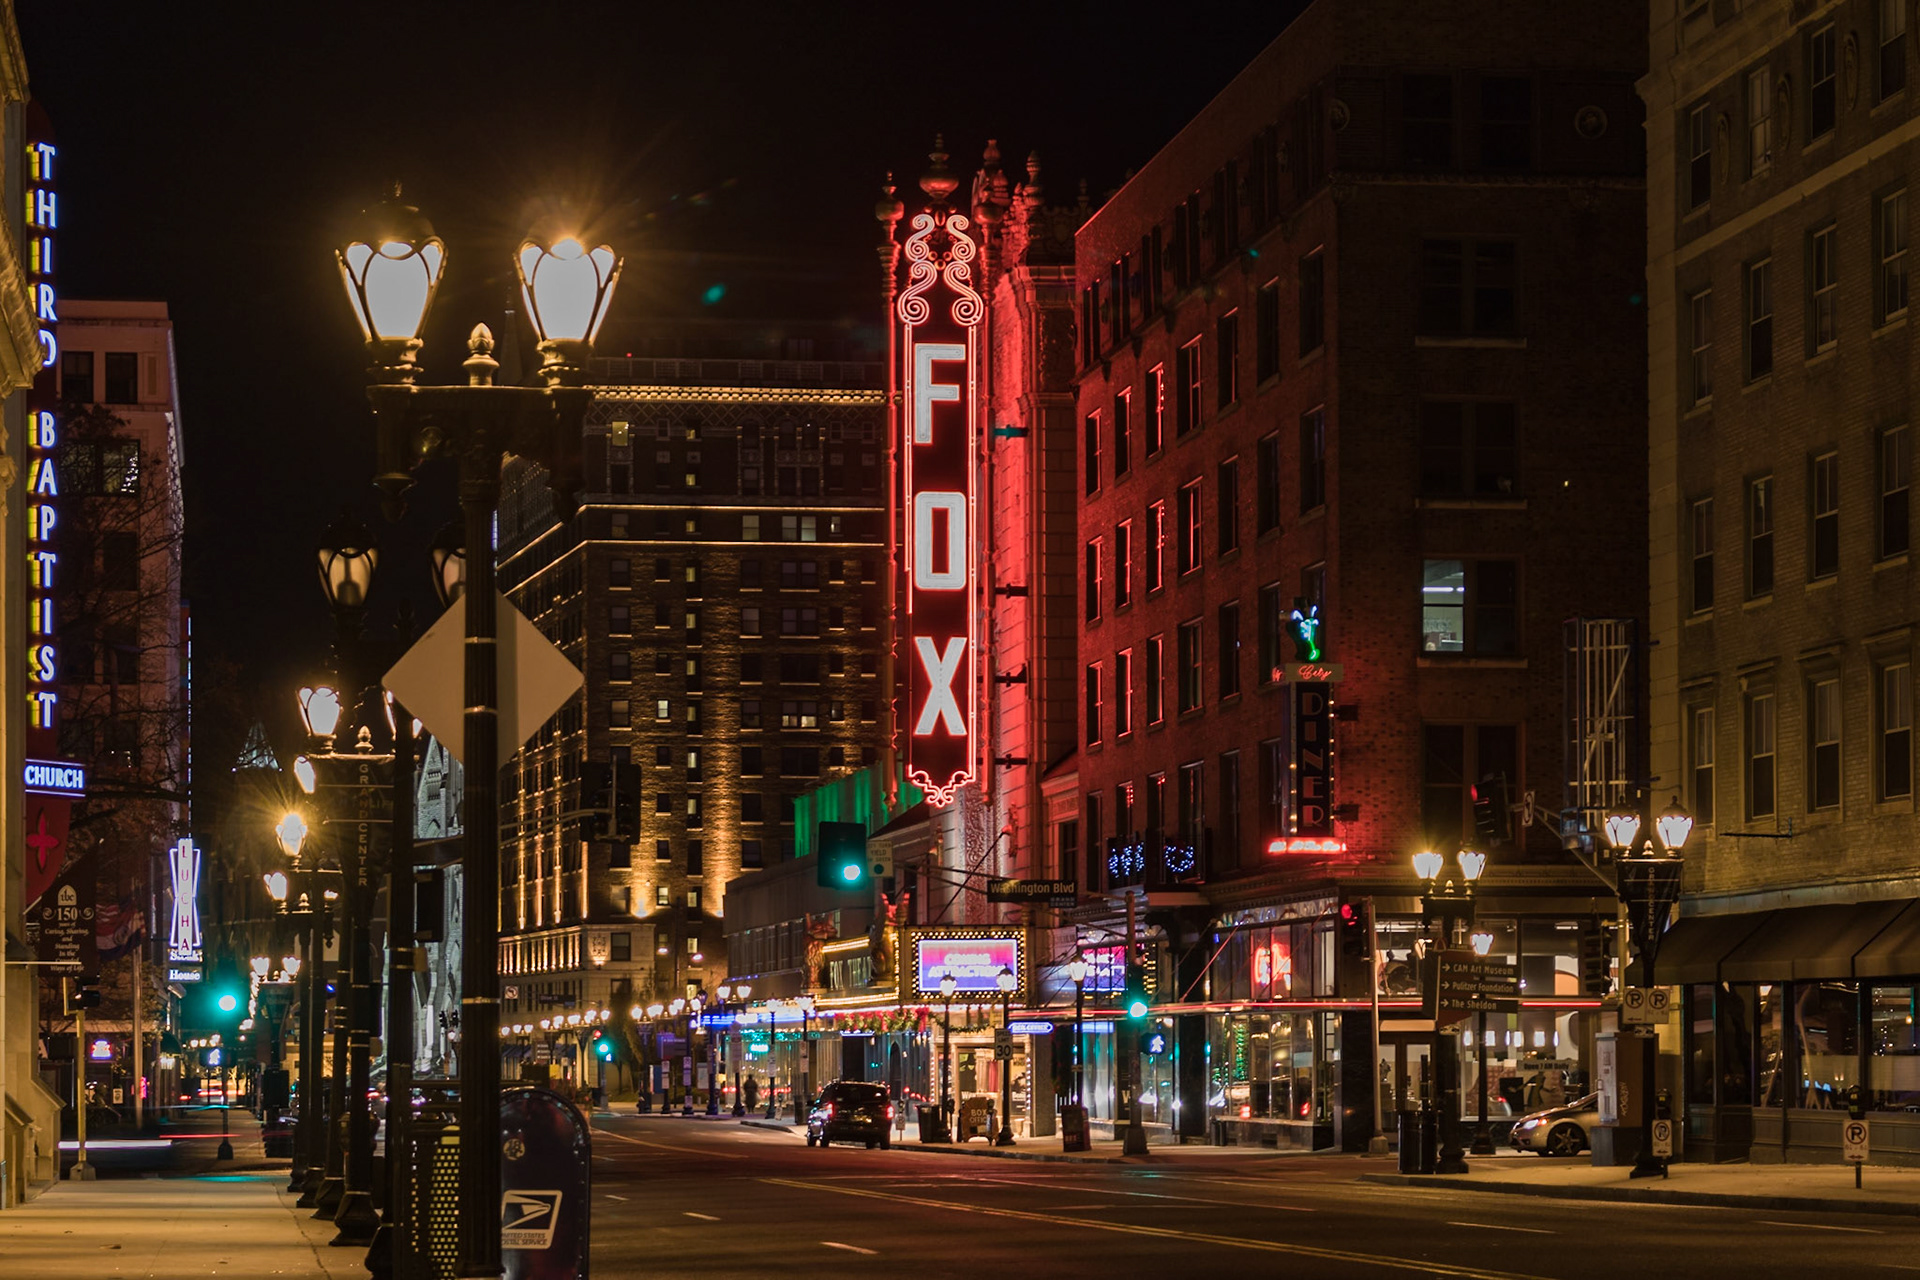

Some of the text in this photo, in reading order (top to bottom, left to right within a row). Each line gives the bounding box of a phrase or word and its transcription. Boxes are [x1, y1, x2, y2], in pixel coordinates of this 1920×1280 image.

[37, 142, 57, 367] THIRD
[914, 343, 967, 736] FOX
[37, 411, 57, 728] BAPTIST
[1302, 692, 1324, 828] DINER
[24, 765, 84, 789] CHURCH
[358, 823, 368, 886] CENTER
[1053, 882, 1075, 893] Blvd
[180, 845, 190, 951] LUCHA
[57, 907, 78, 921] 150
[169, 969, 201, 981] House
[1453, 964, 1514, 975] CAM Art Museum
[1452, 981, 1514, 993] Pulitzer Foundation
[1452, 999, 1497, 1010] The Sheldon
[997, 1044, 1011, 1057] 30
[971, 1108, 987, 1117] BOX
